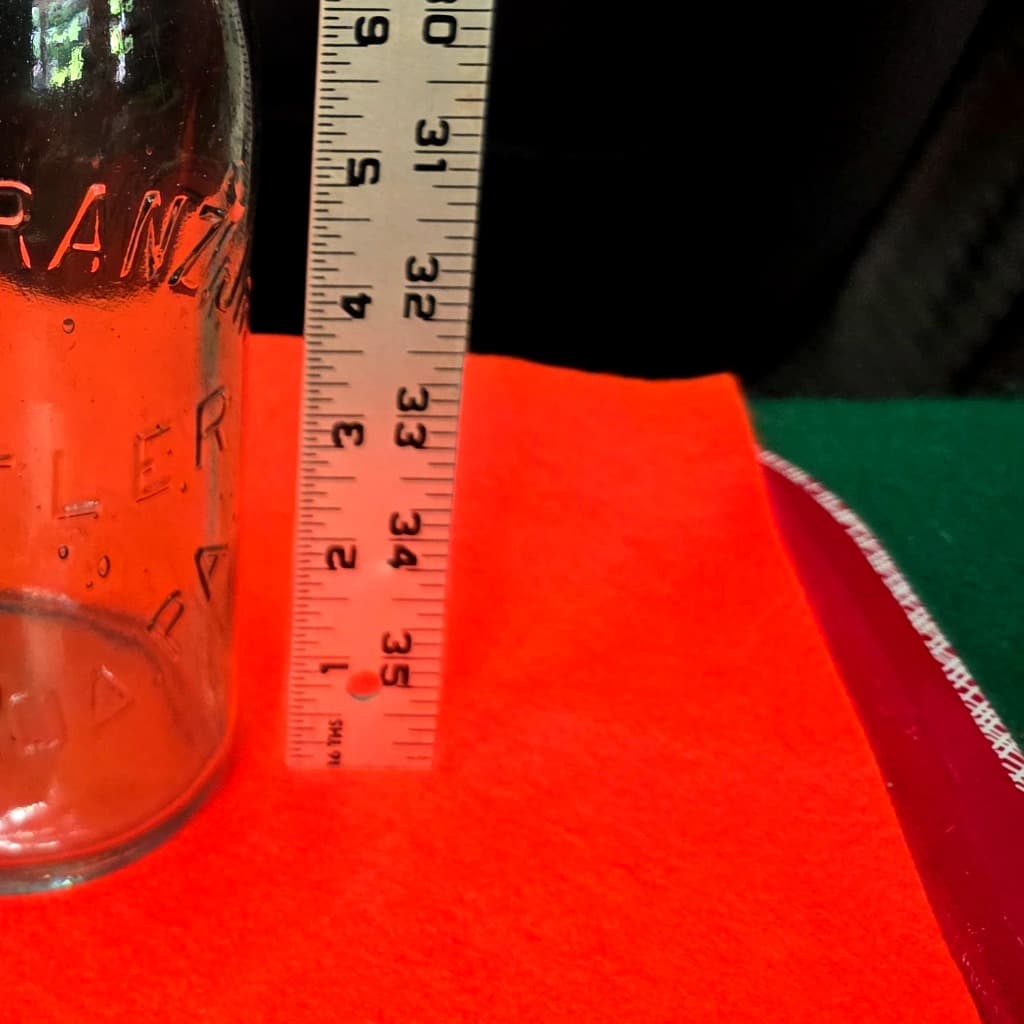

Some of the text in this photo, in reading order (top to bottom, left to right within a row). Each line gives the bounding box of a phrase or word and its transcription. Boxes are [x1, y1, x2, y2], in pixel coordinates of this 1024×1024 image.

[354, 15, 390, 46] 6
[413, 118, 450, 173] 31
[346, 157, 381, 186] 5
[403, 255, 439, 321] 32
[339, 292, 373, 320] 4
[394, 386, 429, 450] 33
[331, 422, 364, 449] 3
[387, 511, 422, 570] 34
[326, 544, 357, 571] 2
[319, 662, 349, 675] 1
[380, 631, 413, 688] 35
